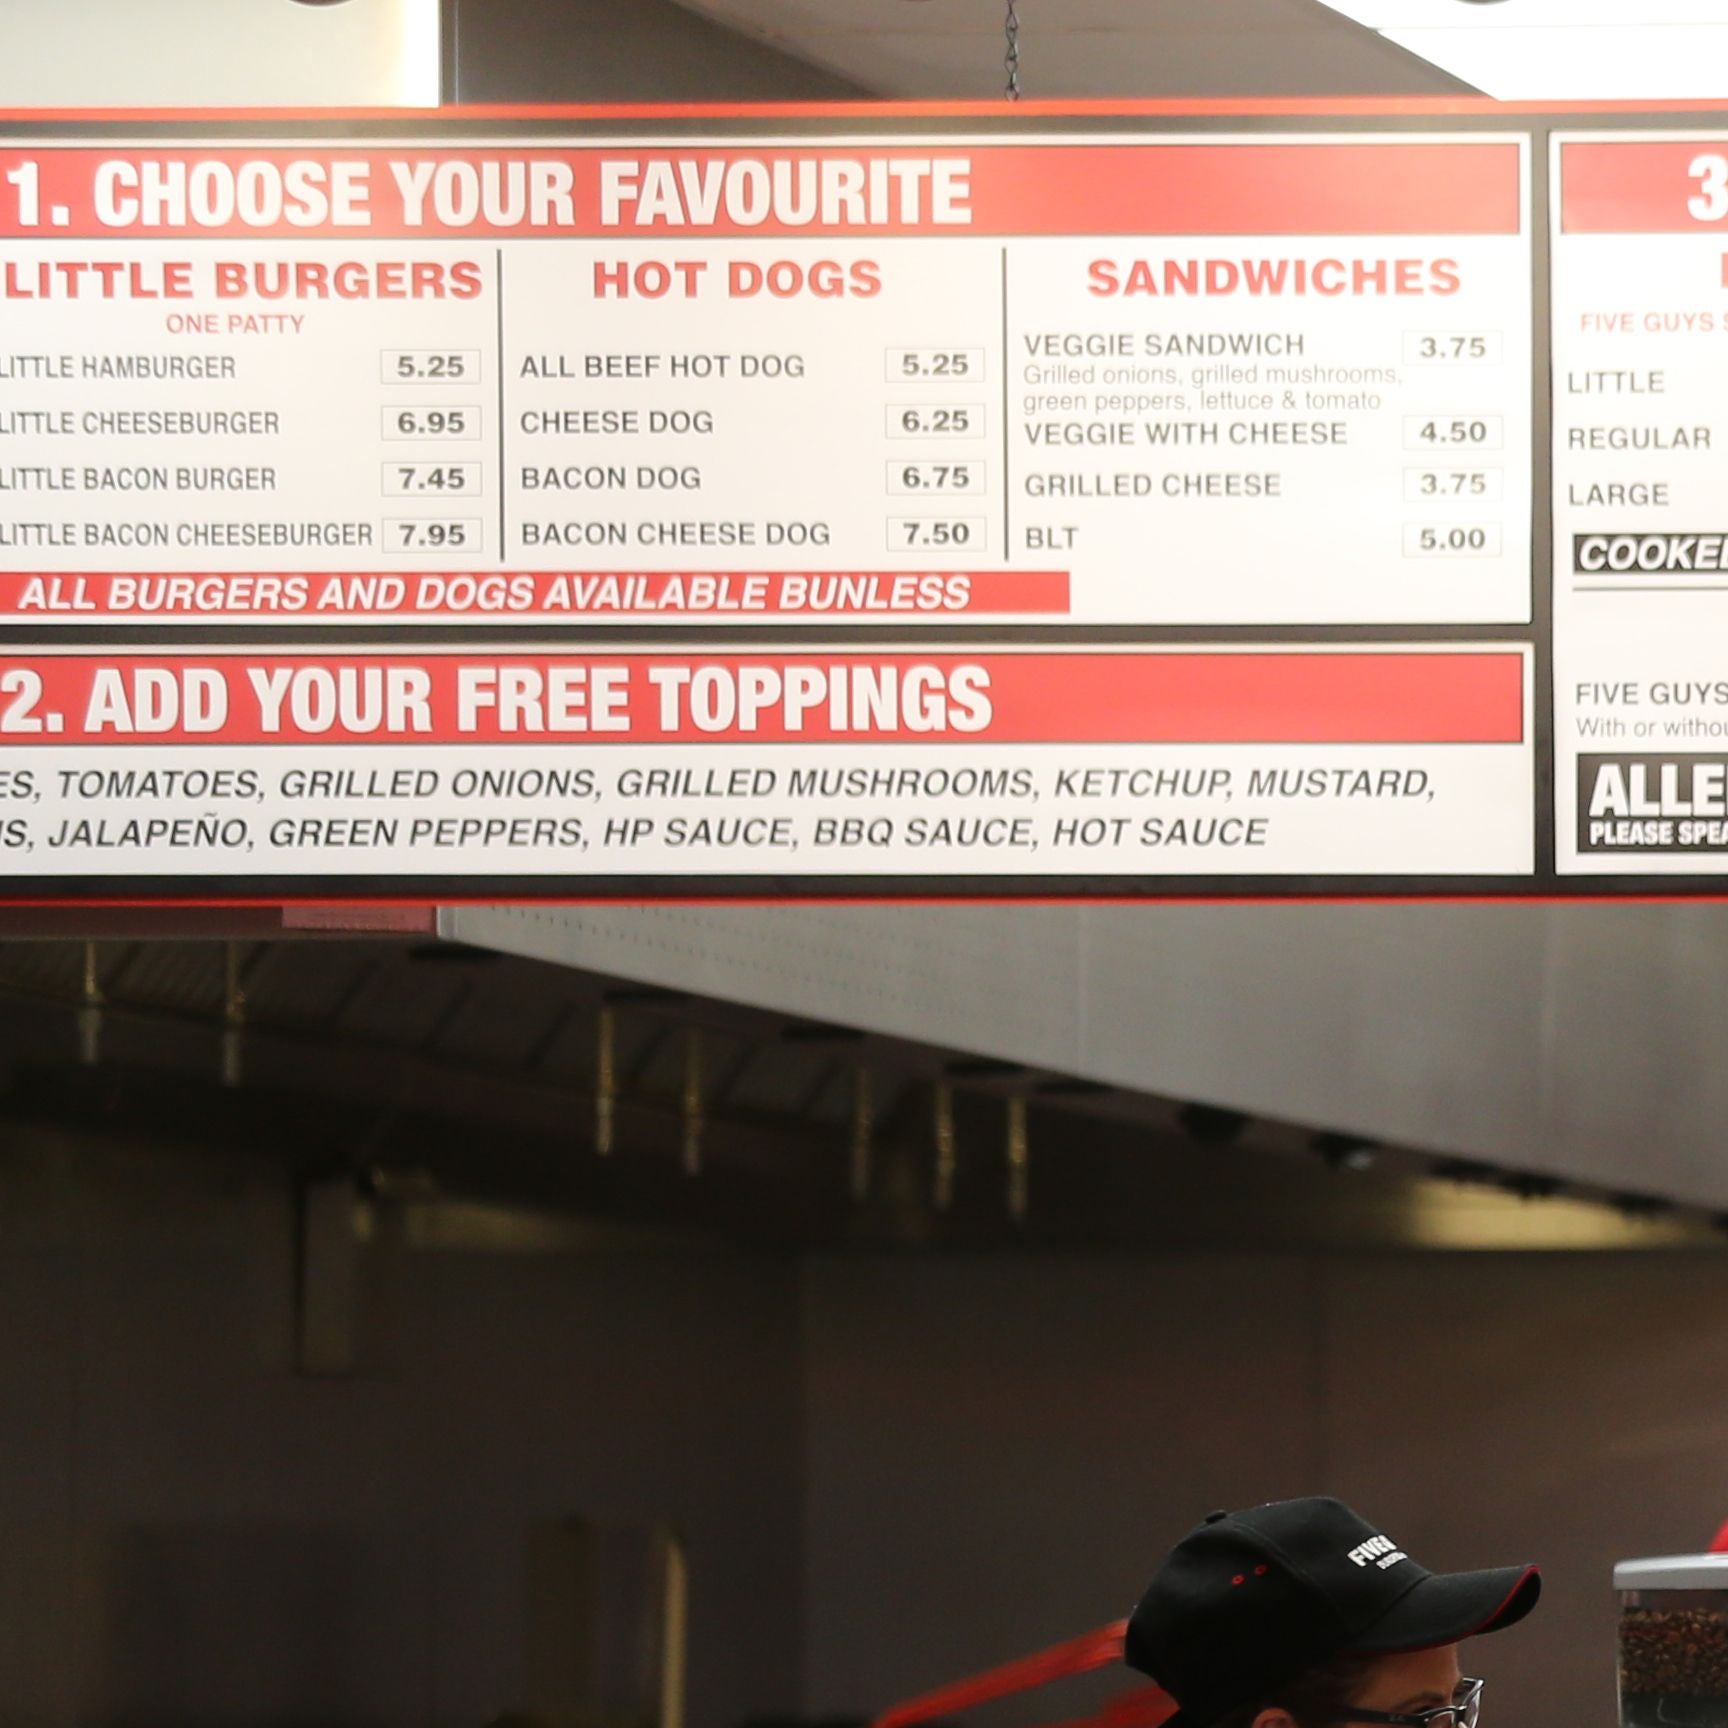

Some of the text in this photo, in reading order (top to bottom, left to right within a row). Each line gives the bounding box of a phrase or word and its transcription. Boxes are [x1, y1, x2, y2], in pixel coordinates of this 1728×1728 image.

[7, 157, 972, 228] 1. CHOOSE YOUR FAVOURITE
[5, 260, 483, 300] LITTLE BURGERS
[593, 259, 882, 299] HOT DOGS
[1088, 258, 1461, 297] SANDWICHES
[166, 313, 305, 334] ONE PATTY
[1023, 333, 1304, 357] VEGGIE SANDWICH
[1420, 336, 1486, 358] 3.75
[0, 355, 236, 379] LITTLE HAMBURGER
[397, 355, 465, 378] 5.25
[520, 354, 805, 378] ALL BEEF HOT DOG
[902, 353, 969, 376] 5.25
[1023, 363, 1402, 390] Grilled onions, grilled mushrooms,
[1567, 370, 1664, 394] LITTLE
[1023, 389, 1381, 417] green peppers, lettuce & tomato
[0, 411, 279, 435] LITTLE CHEESEBURGER
[397, 411, 465, 434] 6.95
[1568, 426, 1711, 450] REGULAR
[521, 466, 701, 490] BACON DOG
[902, 466, 970, 488] 6.75
[1569, 483, 1669, 506] LARGE
[1025, 526, 1078, 549] BLT
[1420, 528, 1486, 550] 5.00
[17, 575, 971, 611] ALL BURGERS AND DOGS AVAILABLE BUNLESS
[0, 663, 993, 733] 2. ADD YOUR FREE TOPPINGS
[1576, 682, 1639, 705] FIVE
[1575, 717, 1626, 738] With
[1633, 721, 1656, 738] or
[58, 769, 265, 801] TOMATOES,
[280, 769, 439, 798] GRILLED
[451, 769, 602, 800] ONIONS,
[617, 768, 777, 797] GRILLED
[788, 768, 1039, 799] MUSHROOMS,
[1054, 769, 1232, 799] KETCHUP,
[1247, 768, 1434, 799] MUSTARD,
[1589, 820, 1674, 845] PLEASE
